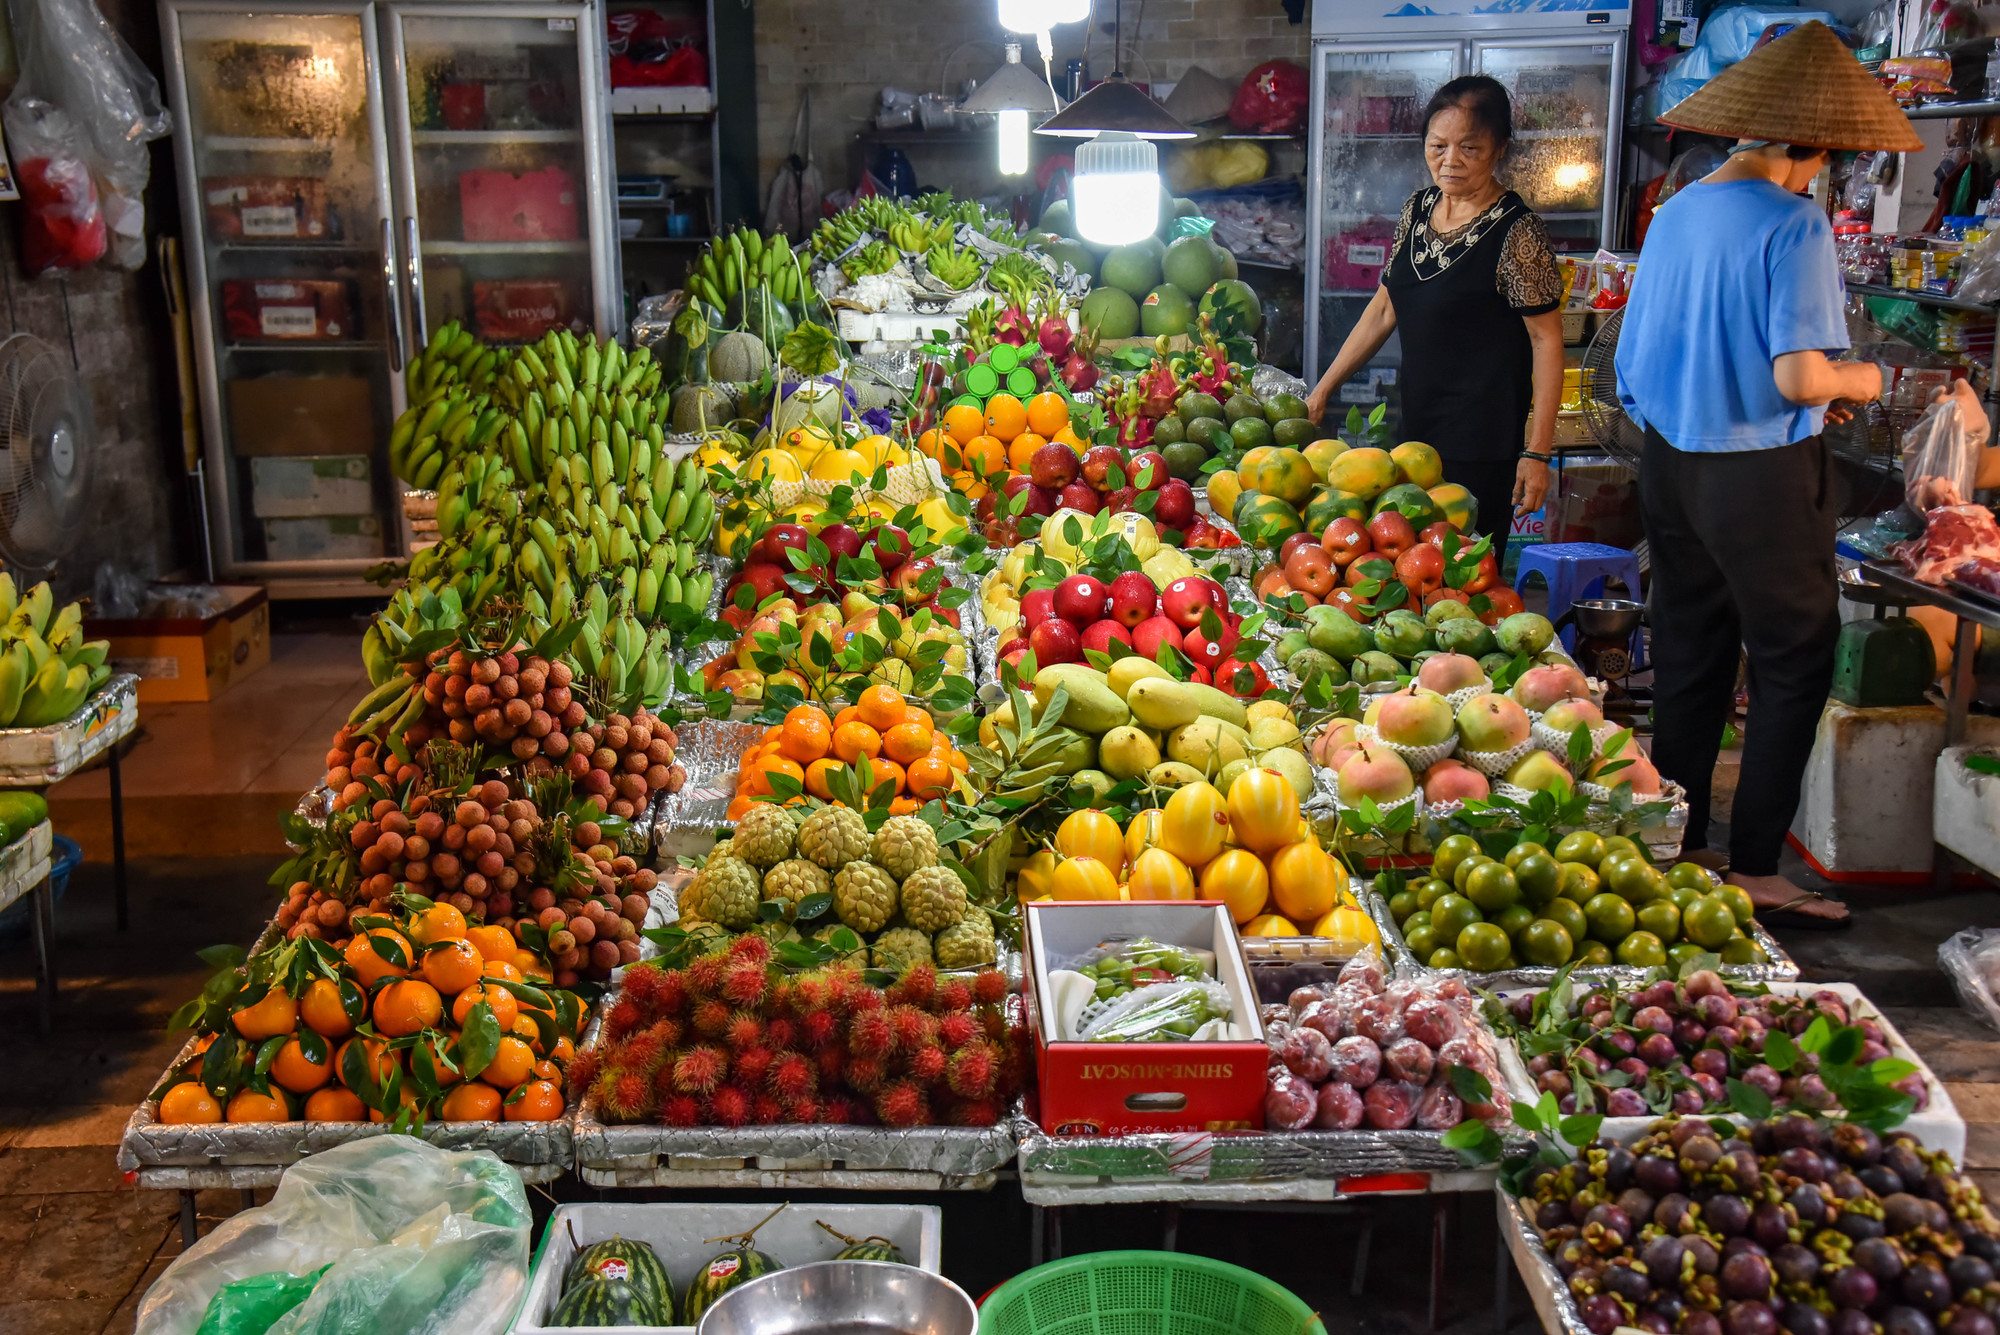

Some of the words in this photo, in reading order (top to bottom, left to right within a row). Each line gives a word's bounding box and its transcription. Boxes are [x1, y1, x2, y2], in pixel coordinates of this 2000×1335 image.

[507, 307, 541, 322] envy
[1512, 515, 1544, 534] Vie
[1080, 1064, 1233, 1079] SHINE-MUSCAT
